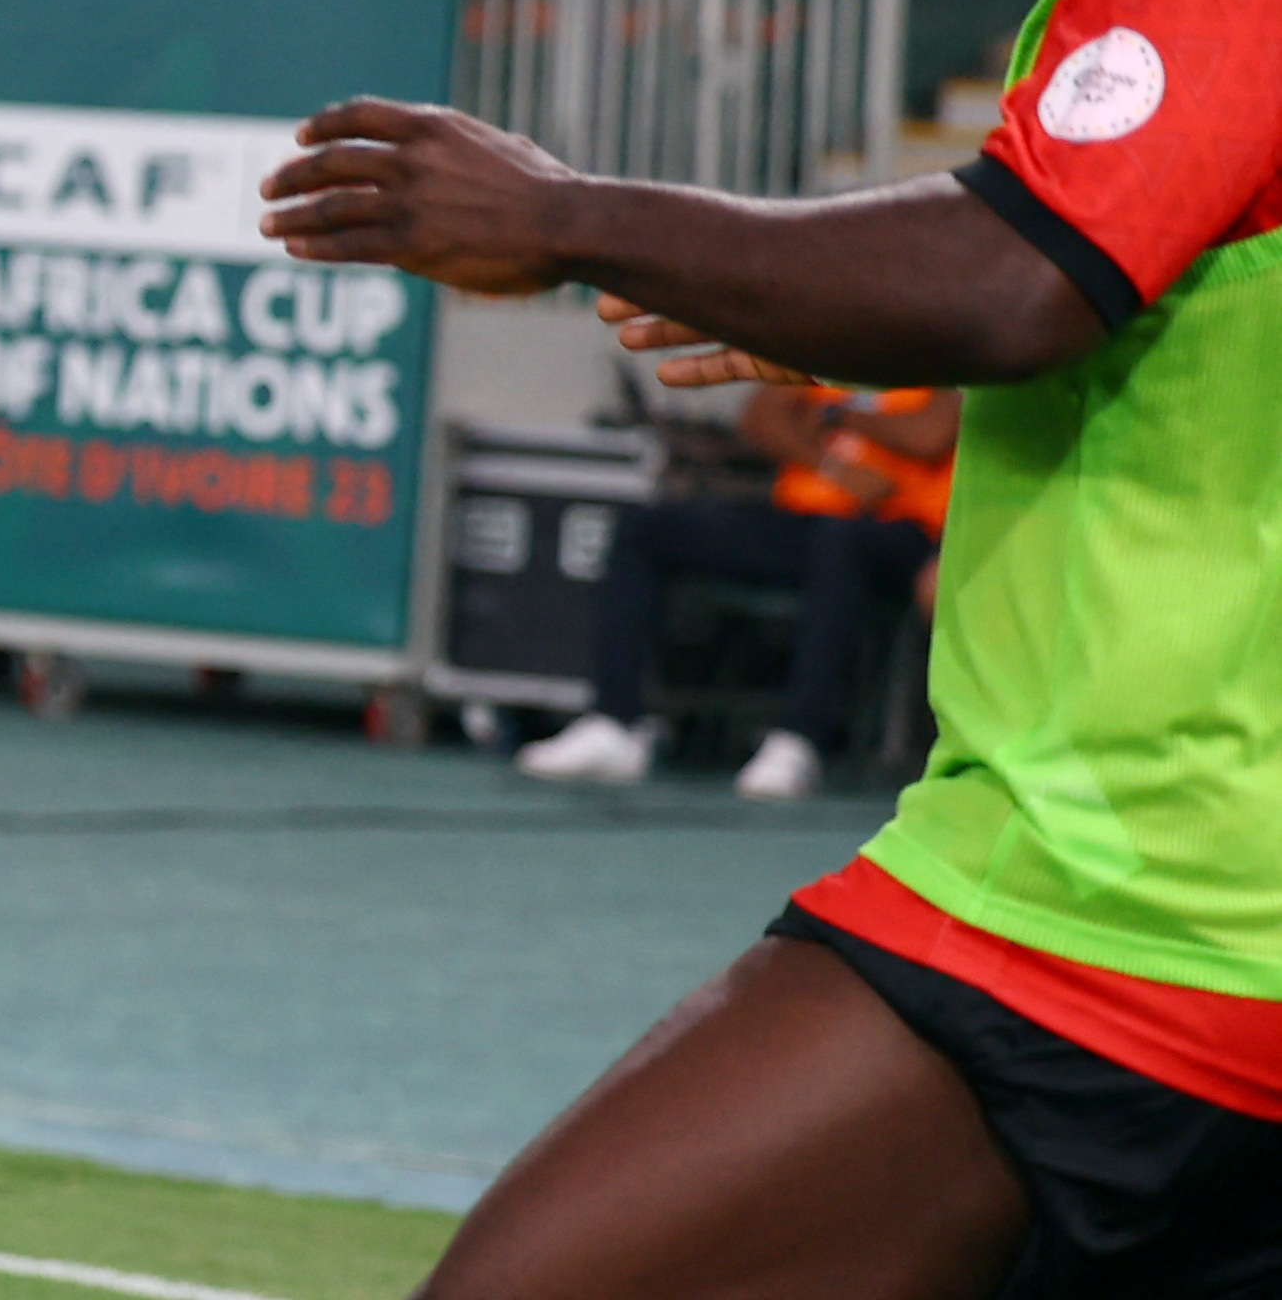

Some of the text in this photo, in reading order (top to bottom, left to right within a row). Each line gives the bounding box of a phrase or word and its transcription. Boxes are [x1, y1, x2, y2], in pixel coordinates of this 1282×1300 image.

[239, 267, 408, 355] CUP
[56, 340, 400, 448] NATIONS
[77, 437, 313, 520] D'IVOIRE
[325, 457, 393, 528] 23
